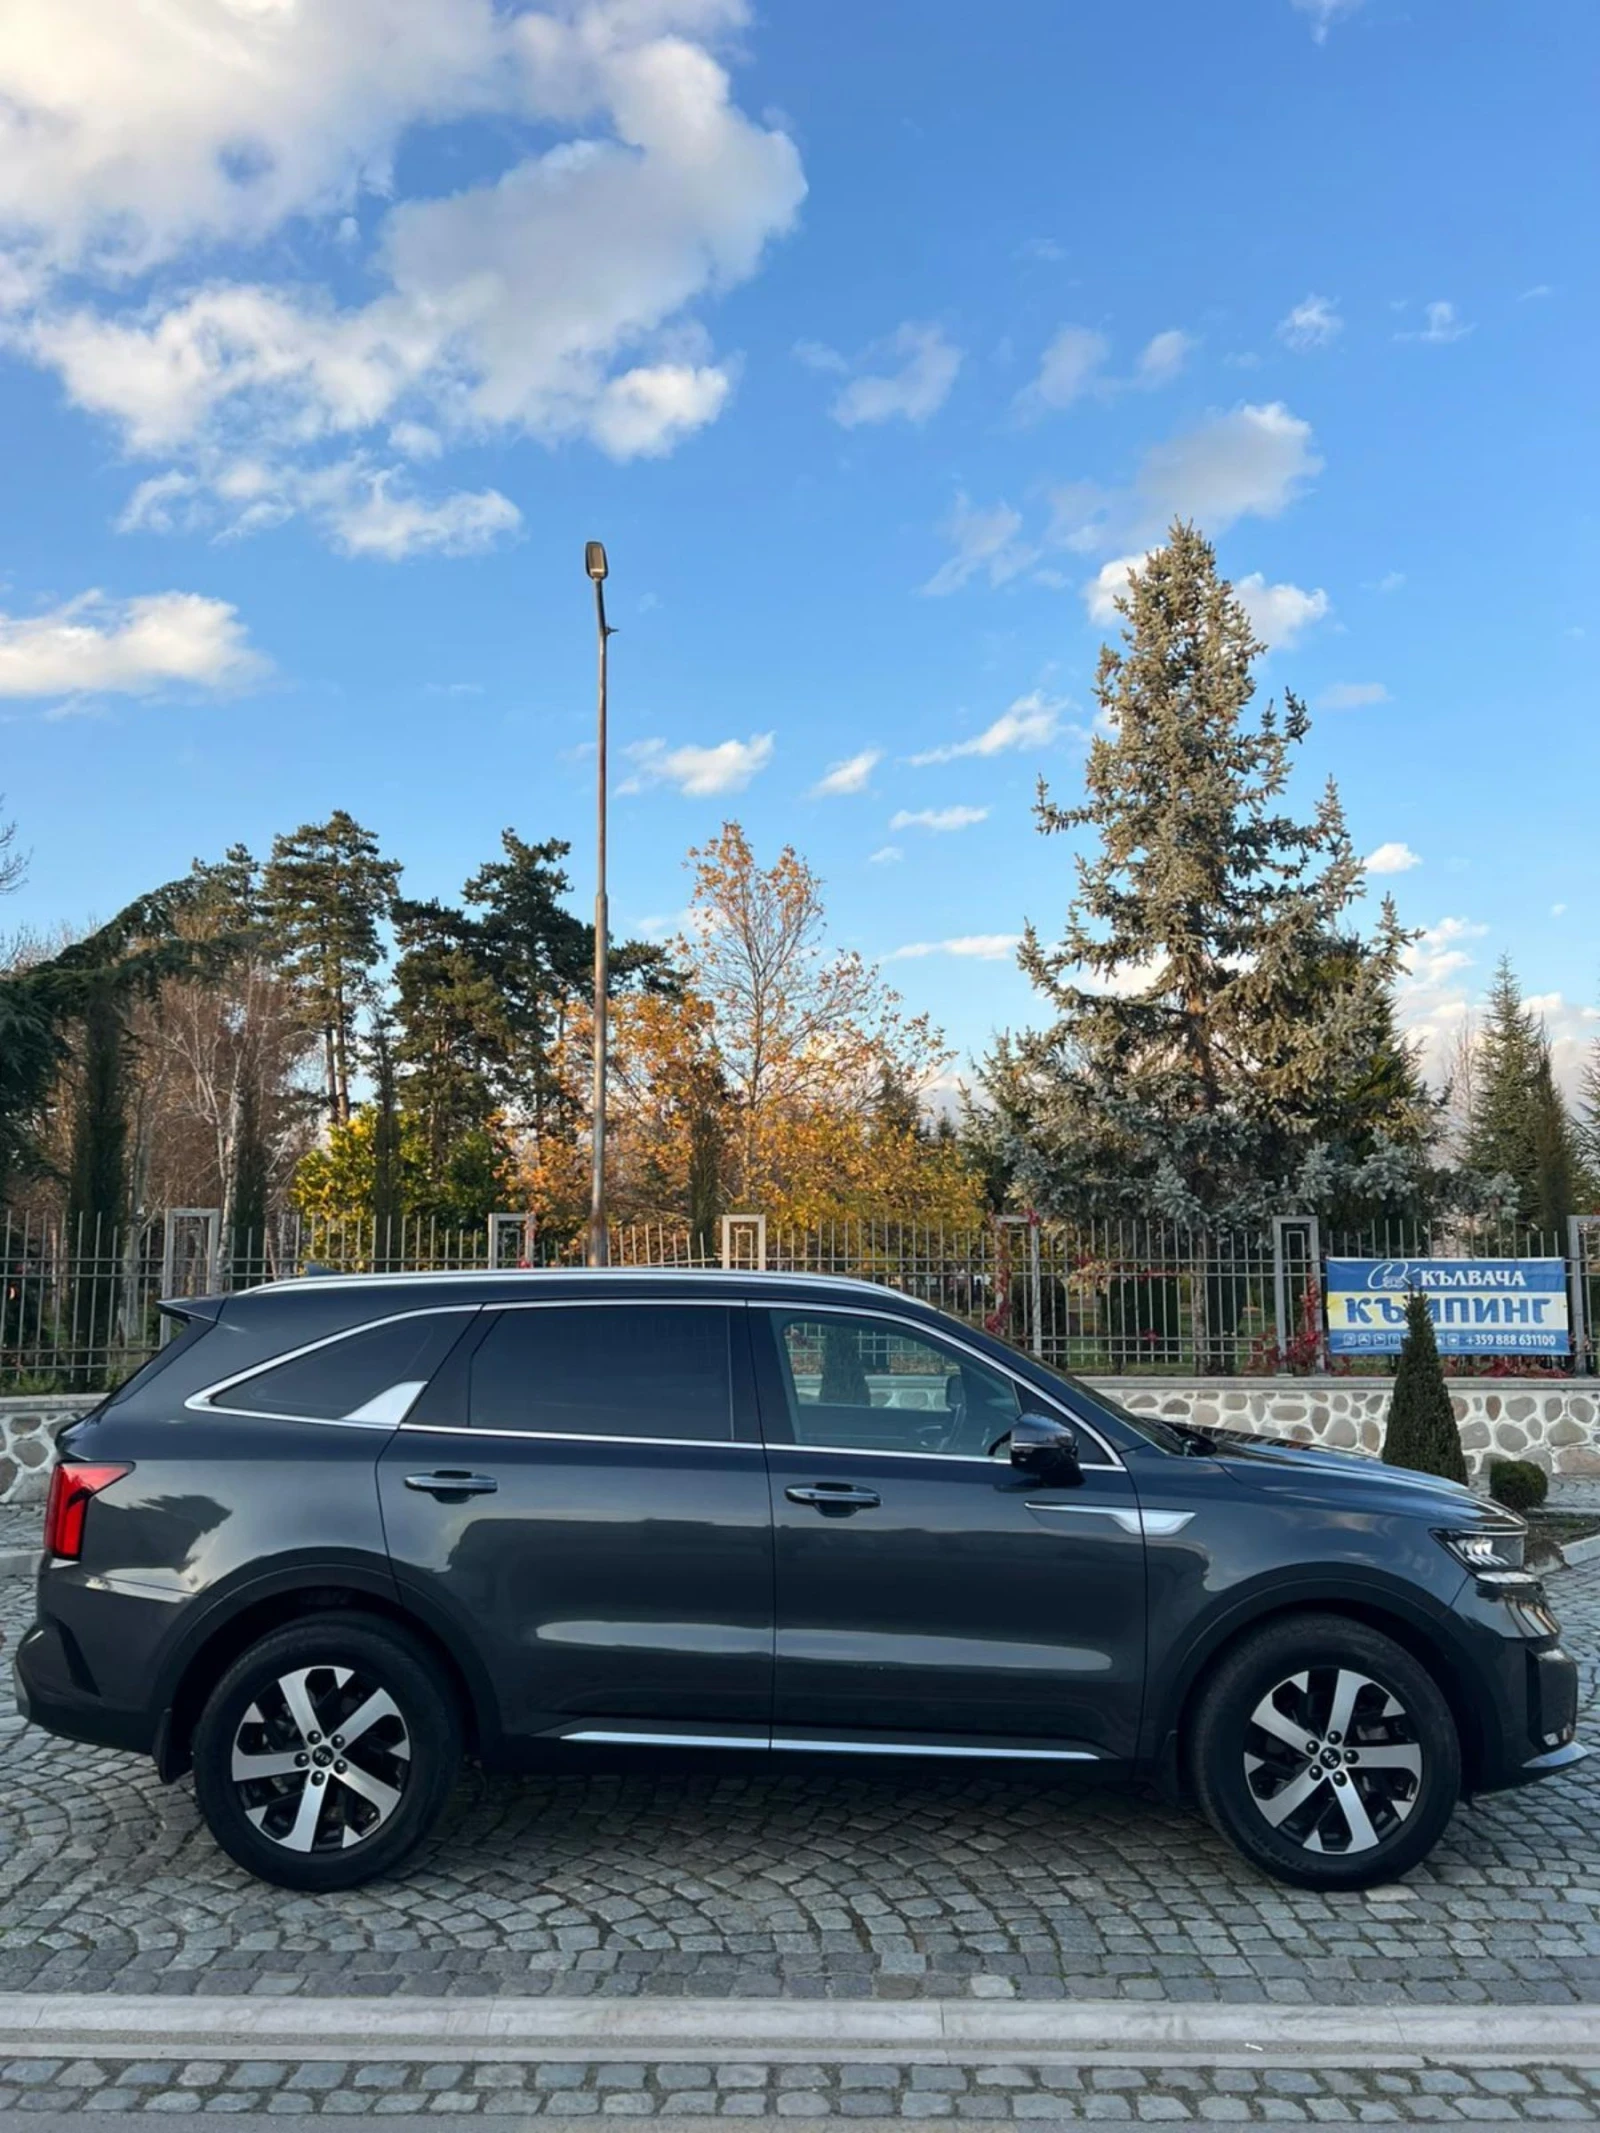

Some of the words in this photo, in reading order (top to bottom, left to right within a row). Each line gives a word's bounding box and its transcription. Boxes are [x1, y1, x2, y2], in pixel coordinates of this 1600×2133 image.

[1421, 1270, 1526, 1286] КЪЛВАЧА
[1466, 1335, 1494, 1345] +359
[1496, 1335, 1517, 1345] 888
[1519, 1335, 1556, 1346] 631100
[1323, 1750, 1338, 1767] KIA
